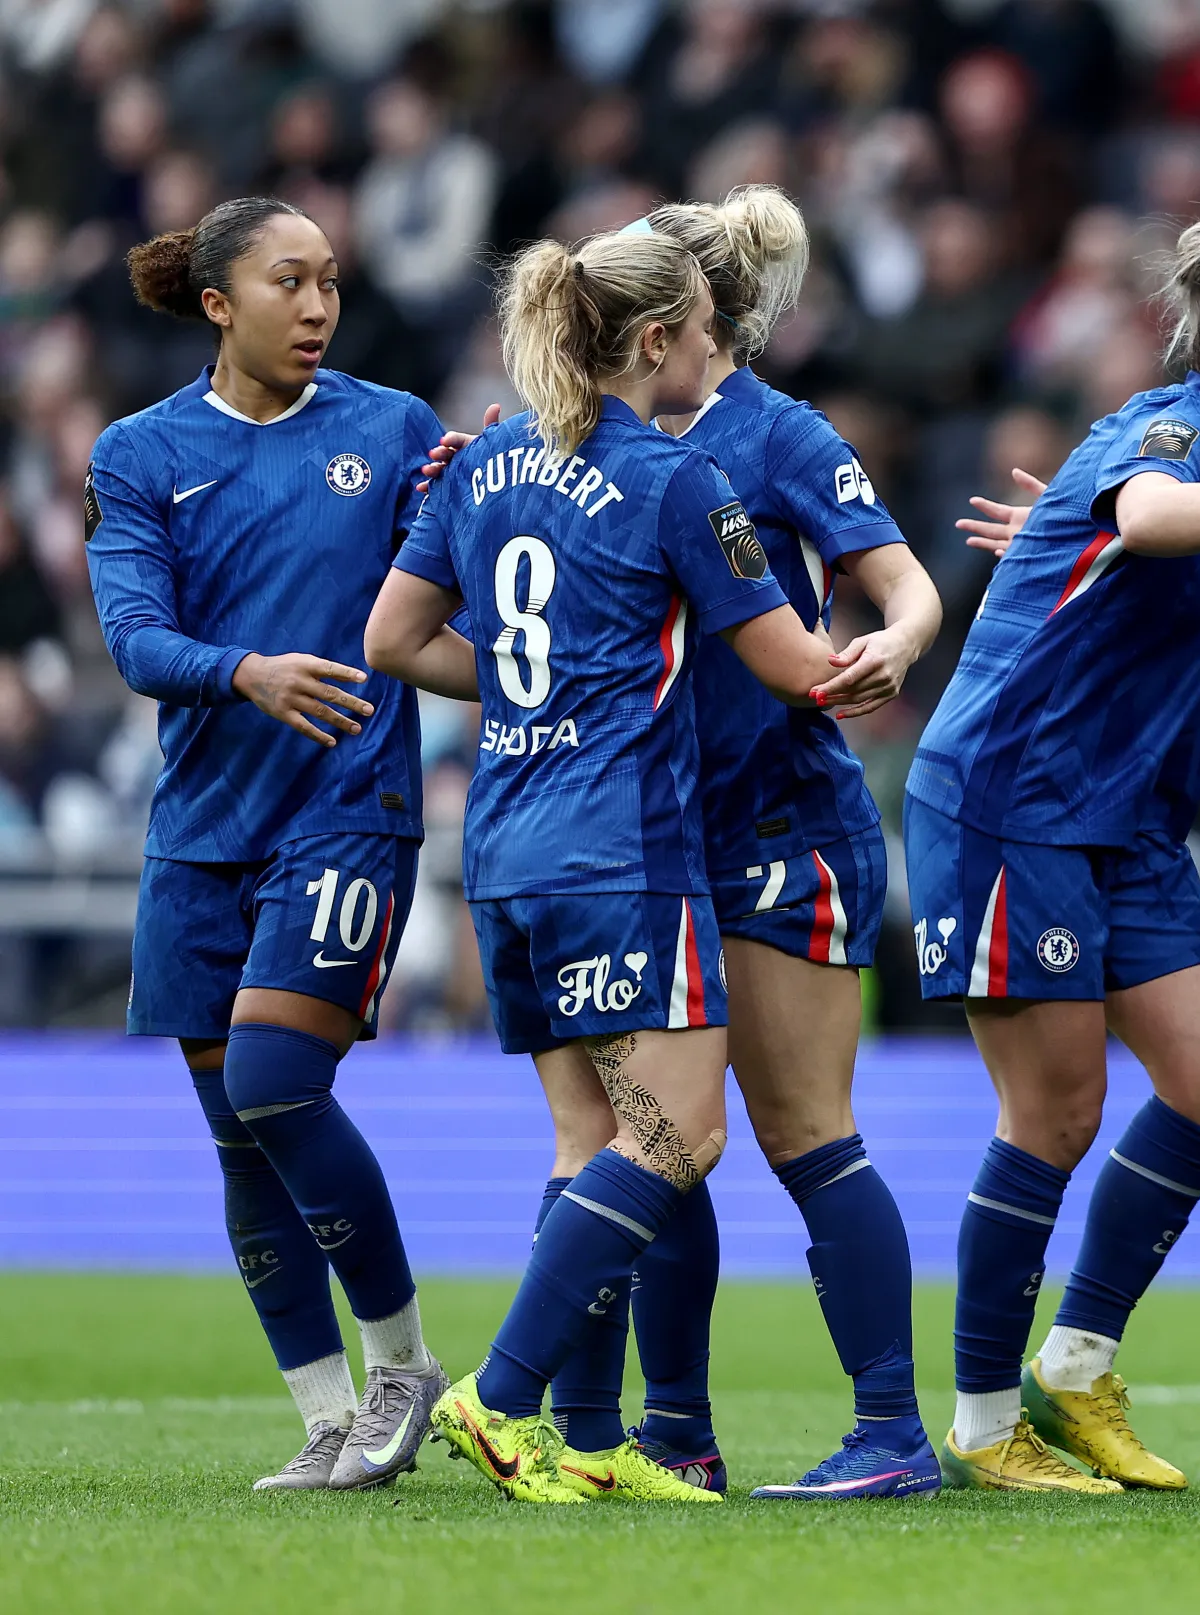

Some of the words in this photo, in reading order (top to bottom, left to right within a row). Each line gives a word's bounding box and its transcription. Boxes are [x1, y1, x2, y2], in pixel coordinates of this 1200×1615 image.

[334, 455, 363, 466] CHELSEA
[472, 447, 625, 519] CUTHBERT
[721, 513, 750, 537] WSL
[493, 535, 556, 709] 8
[306, 868, 378, 951] 10
[914, 917, 947, 976] lo
[1045, 930, 1072, 940] CHELSEA
[557, 953, 642, 1017] Flo
[308, 1219, 352, 1236] CFC
[239, 1250, 278, 1270] CFC
